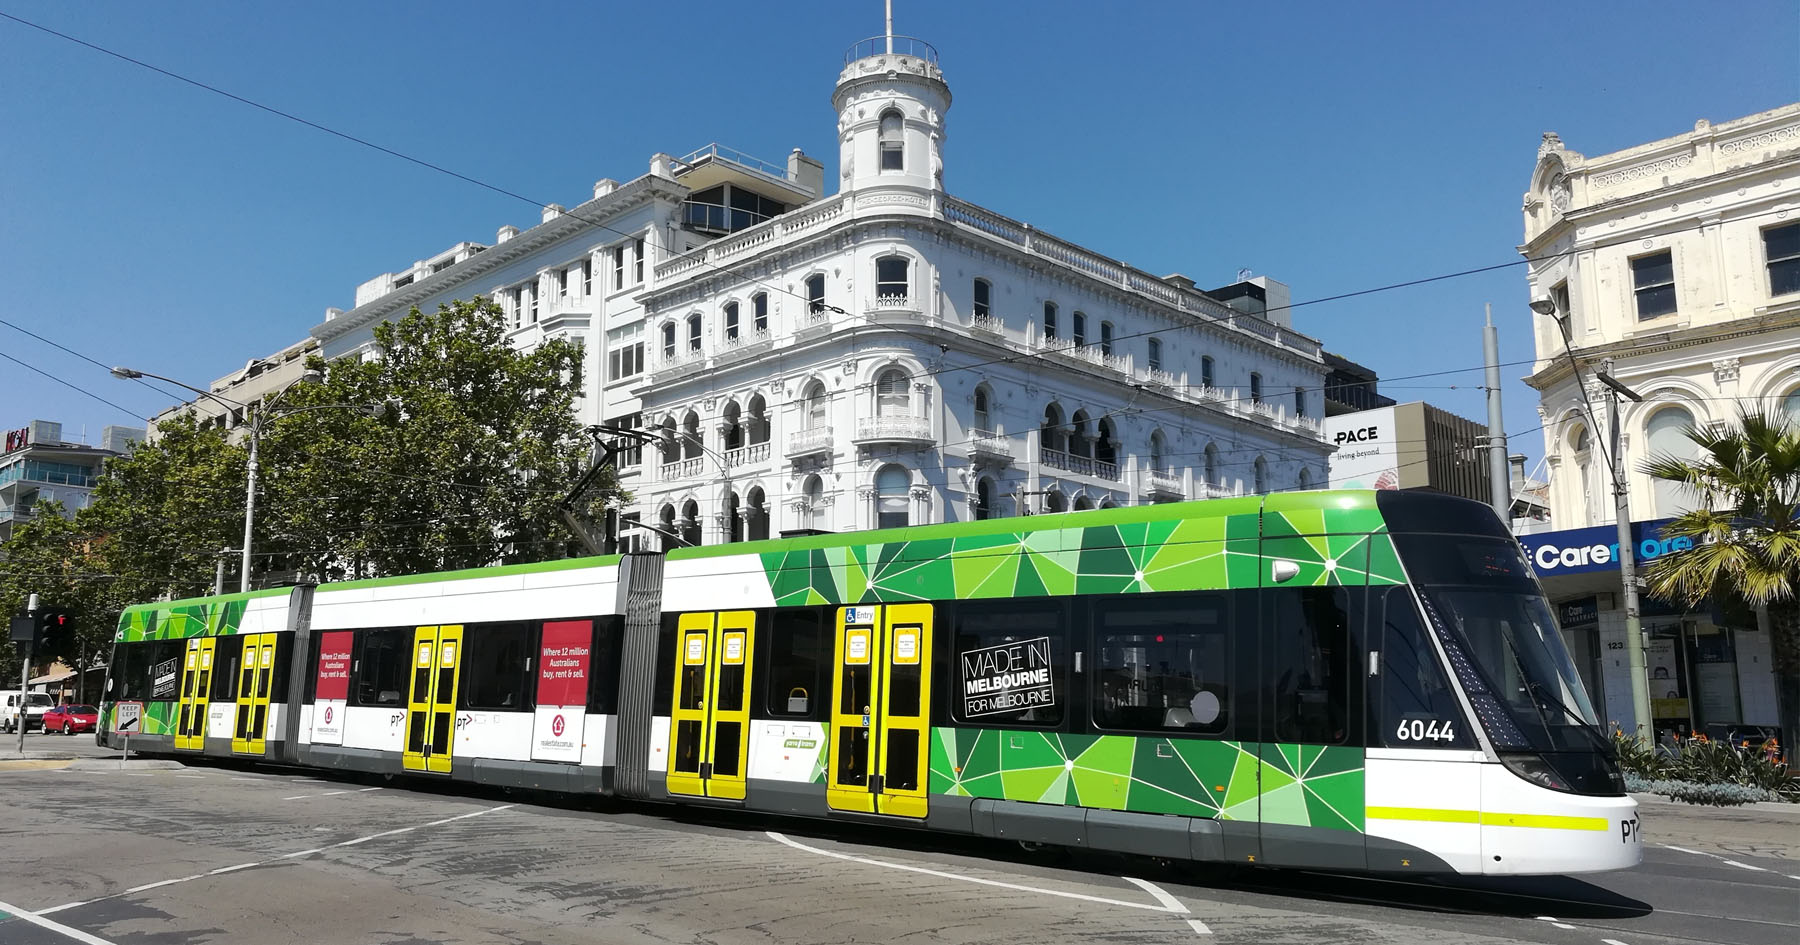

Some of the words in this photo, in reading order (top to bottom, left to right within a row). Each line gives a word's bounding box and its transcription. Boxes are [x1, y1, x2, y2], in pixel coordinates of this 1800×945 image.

[1334, 426, 1378, 445] PACE
[1356, 447, 1380, 458] beyond
[856, 611, 873, 620] Entry
[543, 647, 561, 656] Where
[561, 647, 568, 656] 12
[569, 647, 589, 656] million
[1607, 642, 1624, 650] 123
[549, 658, 580, 667] Australians
[965, 646, 1024, 679] MADE
[1028, 642, 1048, 668] IN
[543, 669, 555, 680] buy,
[555, 670, 567, 678] rent
[567, 670, 573, 678] &
[966, 668, 1049, 695] MELBOURNE
[968, 699, 988, 713] FOR
[989, 689, 1051, 710] MELBOURNE
[1396, 719, 1455, 742] 6044
